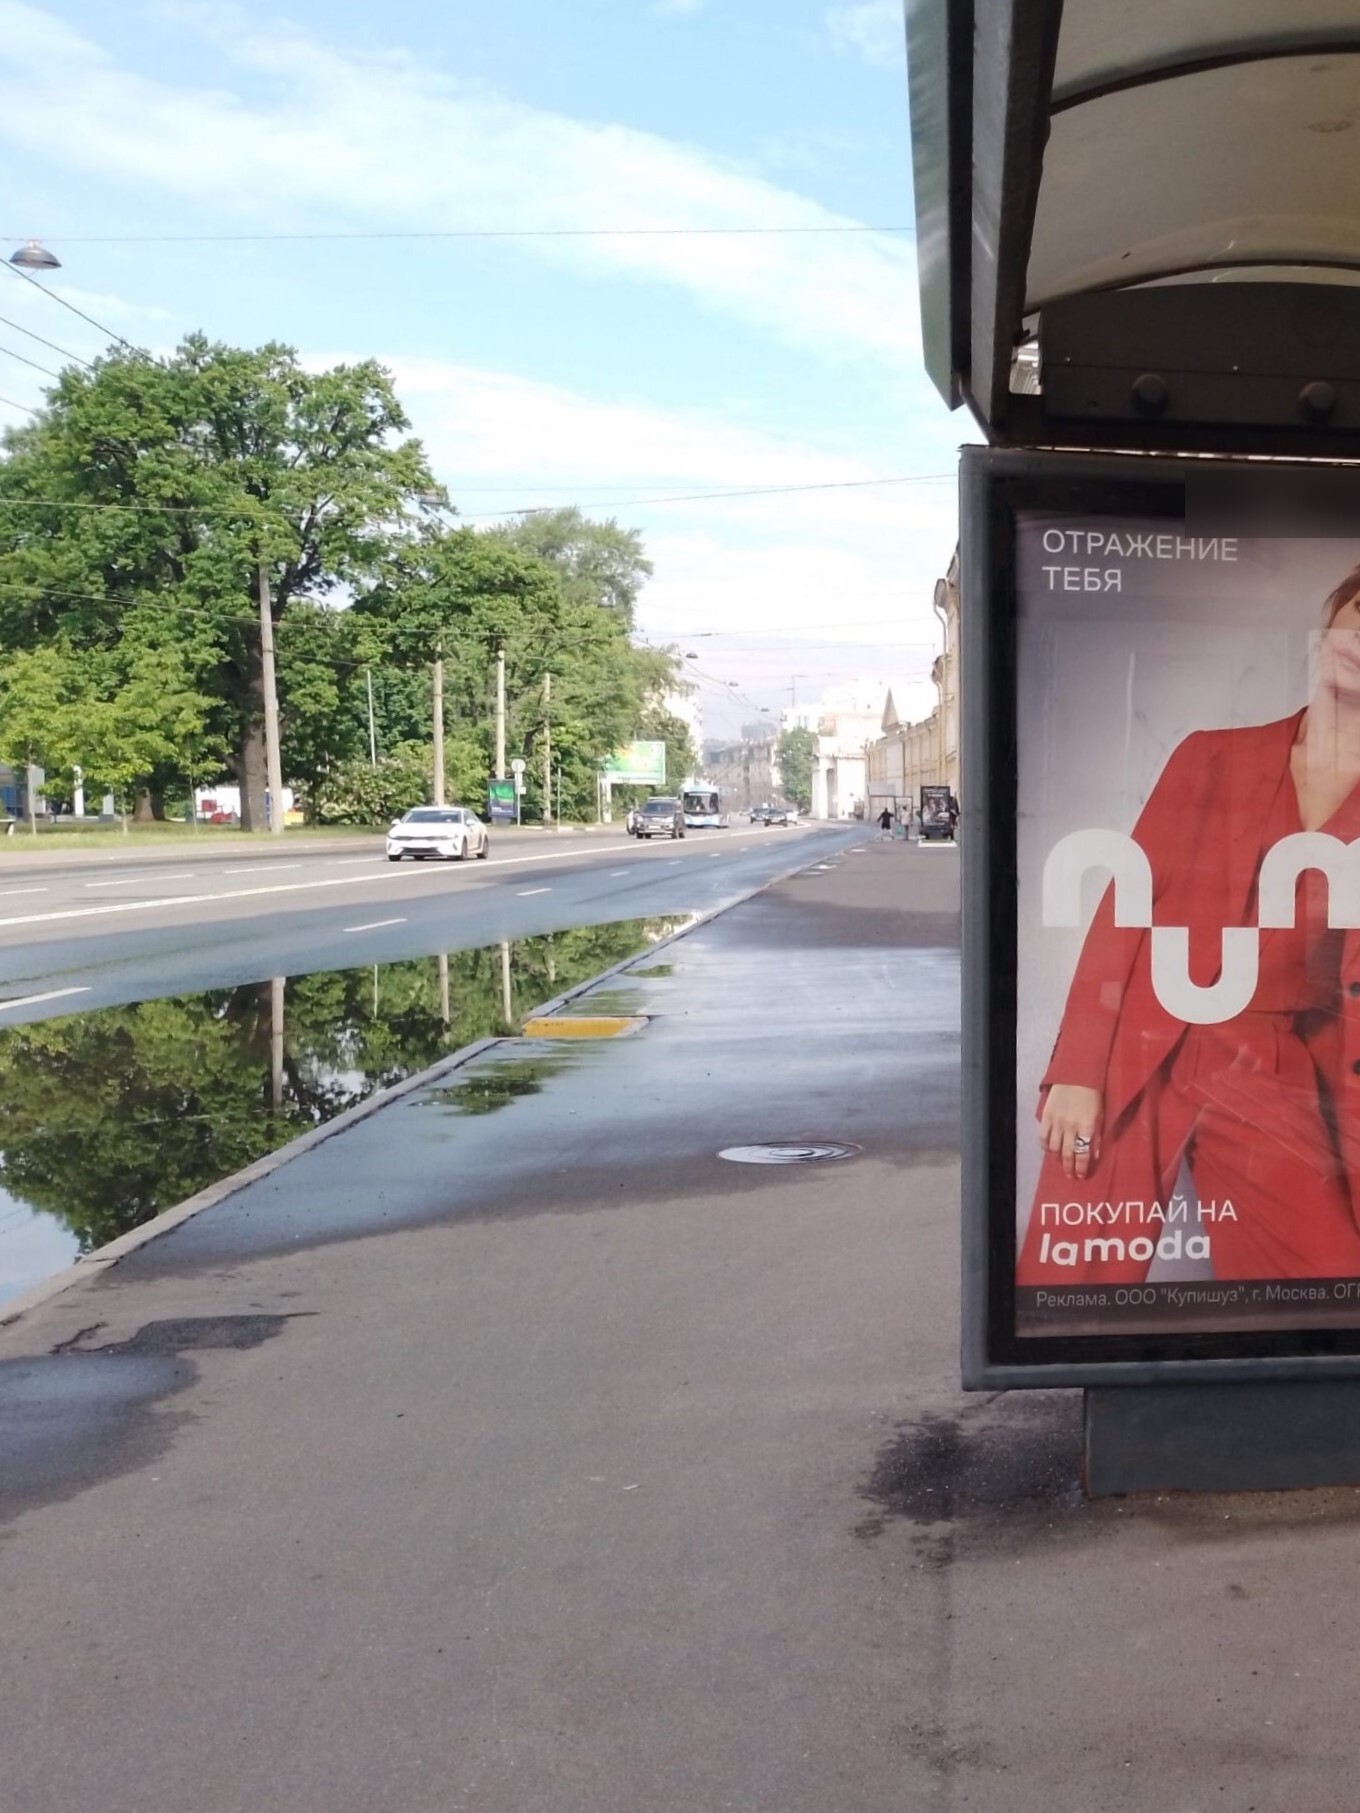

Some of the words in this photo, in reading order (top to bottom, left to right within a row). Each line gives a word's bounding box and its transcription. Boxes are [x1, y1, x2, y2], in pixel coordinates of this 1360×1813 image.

[1042, 529, 1239, 561] ОТРАЖЕНИЕ
[1043, 567, 1123, 592] ТЕБЯ
[1040, 1195, 1188, 1226] ПОКУПАЙ
[1197, 1200, 1238, 1222] НА
[1039, 1230, 1211, 1266] lamoda
[1036, 1291, 1111, 1307] Реклама.
[1115, 1289, 1156, 1305] ООО
[1252, 1289, 1263, 1301] г.
[1266, 1284, 1330, 1301] Москва.
